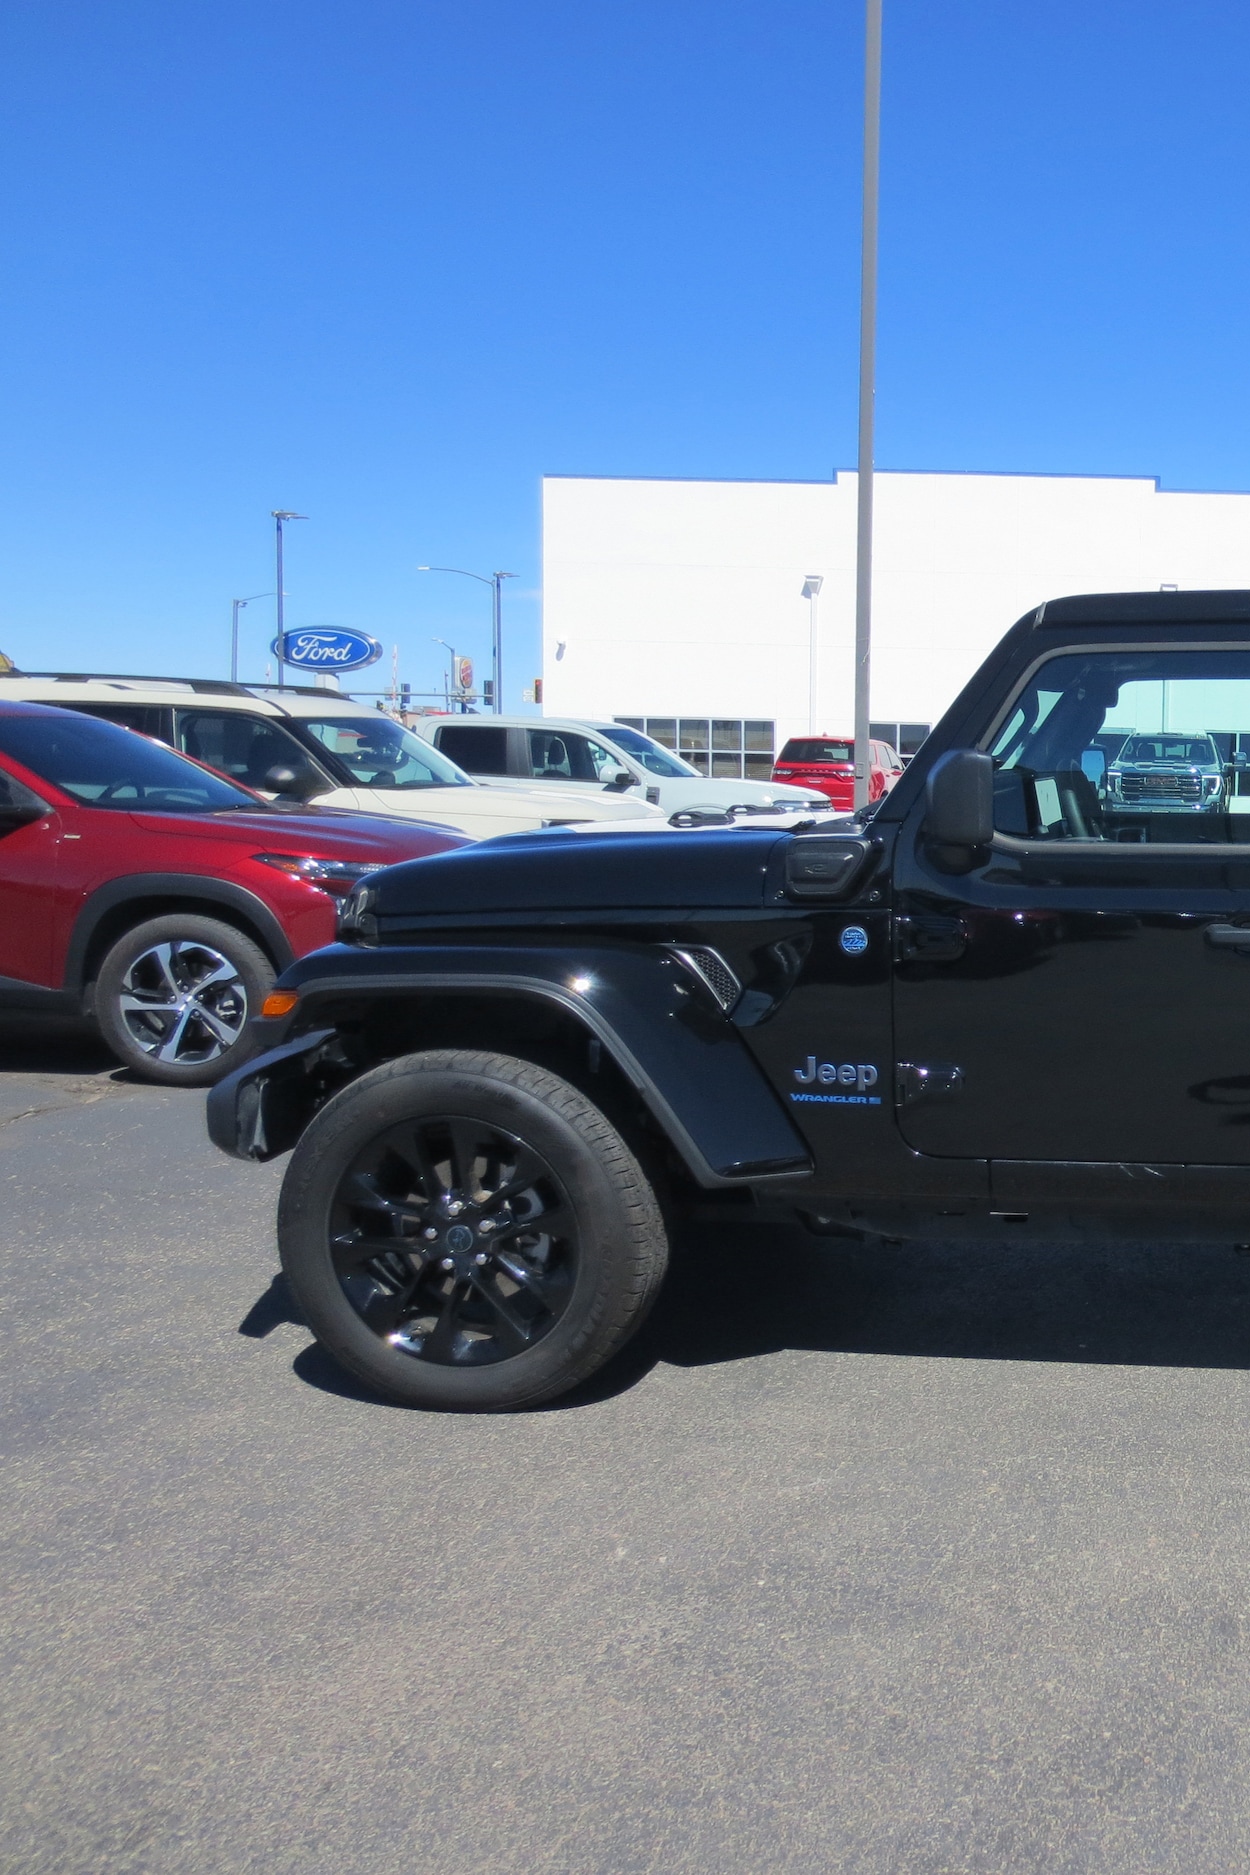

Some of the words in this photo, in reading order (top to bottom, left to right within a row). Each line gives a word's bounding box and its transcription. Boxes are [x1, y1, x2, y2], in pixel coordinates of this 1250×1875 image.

[292, 634, 352, 661] Ford
[794, 1055, 878, 1091] Jeep
[790, 1093, 867, 1104] WRANGLER
